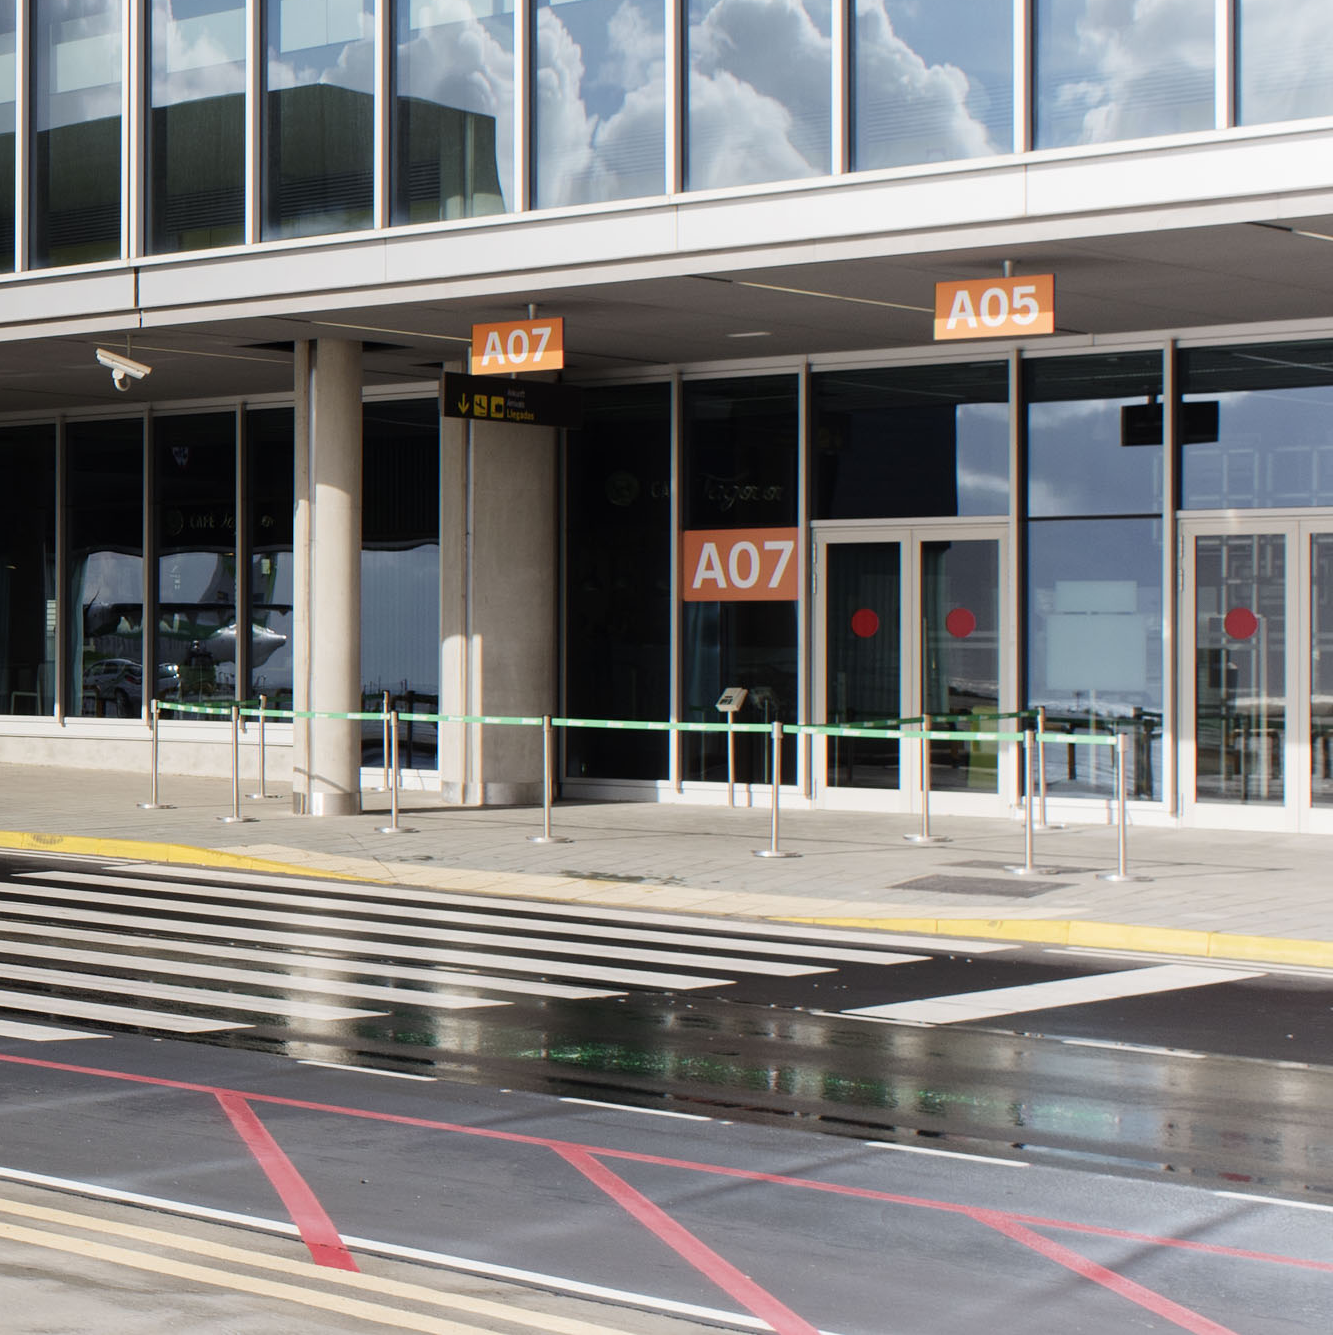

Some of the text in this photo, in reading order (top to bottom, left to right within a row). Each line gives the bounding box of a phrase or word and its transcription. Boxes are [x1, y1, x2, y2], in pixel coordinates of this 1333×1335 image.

[946, 285, 1039, 330] A05
[481, 327, 552, 366] A07
[692, 540, 795, 589] A07
